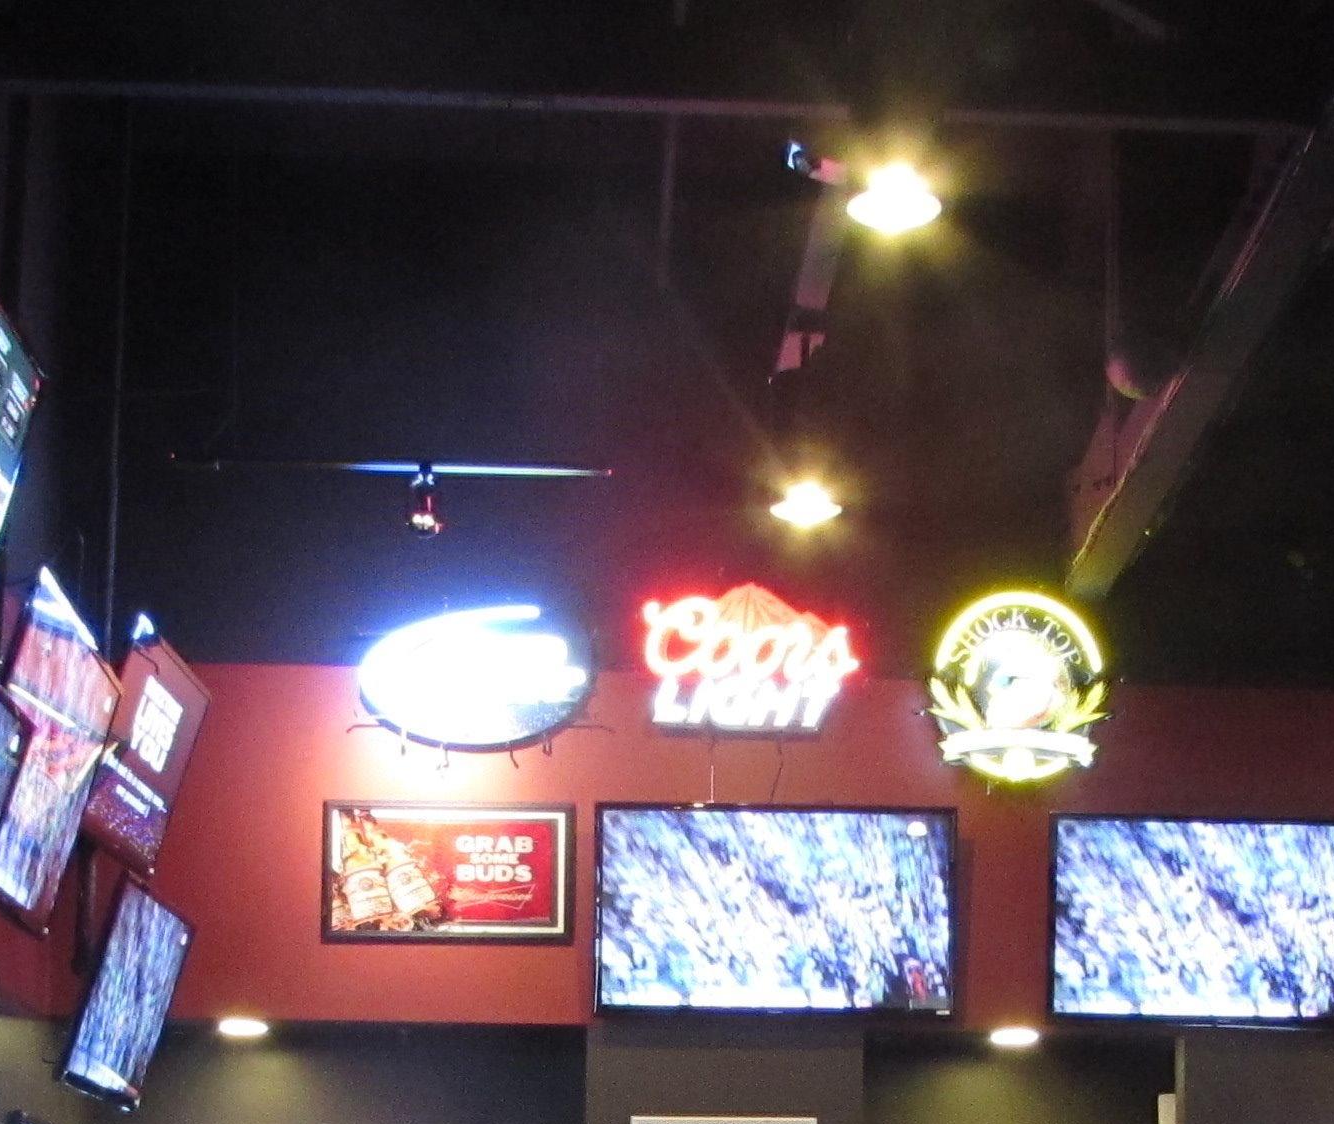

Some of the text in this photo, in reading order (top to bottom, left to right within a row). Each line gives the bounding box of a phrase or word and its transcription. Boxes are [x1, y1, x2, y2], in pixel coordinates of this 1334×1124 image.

[643, 596, 861, 678] Coors
[950, 607, 1083, 664] SHOCK TOP
[652, 674, 841, 729] LIGHT
[454, 835, 535, 853] GRAB
[470, 852, 519, 864] SOME
[456, 865, 533, 882] BUDS
